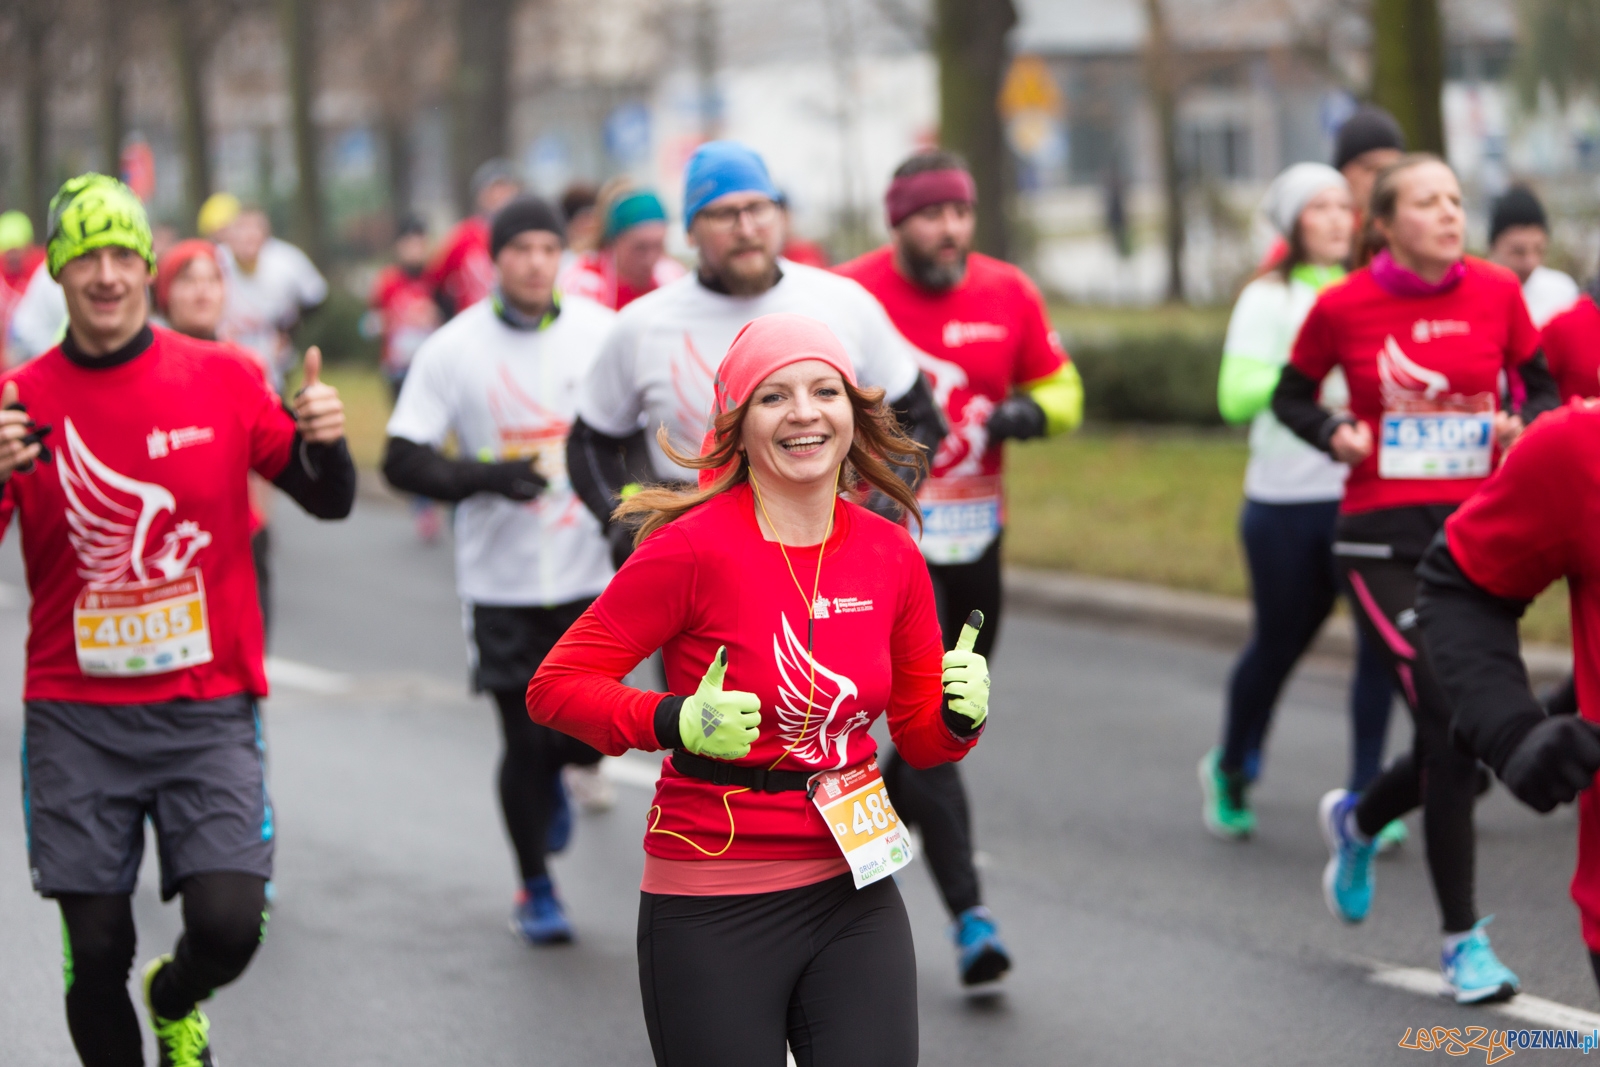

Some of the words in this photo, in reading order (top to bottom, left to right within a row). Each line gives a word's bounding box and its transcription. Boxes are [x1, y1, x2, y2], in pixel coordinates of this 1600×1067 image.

[94, 604, 192, 646] 4065
[835, 822, 848, 836] D
[859, 860, 879, 873] GRUPA
[861, 865, 885, 881] LUXMED
